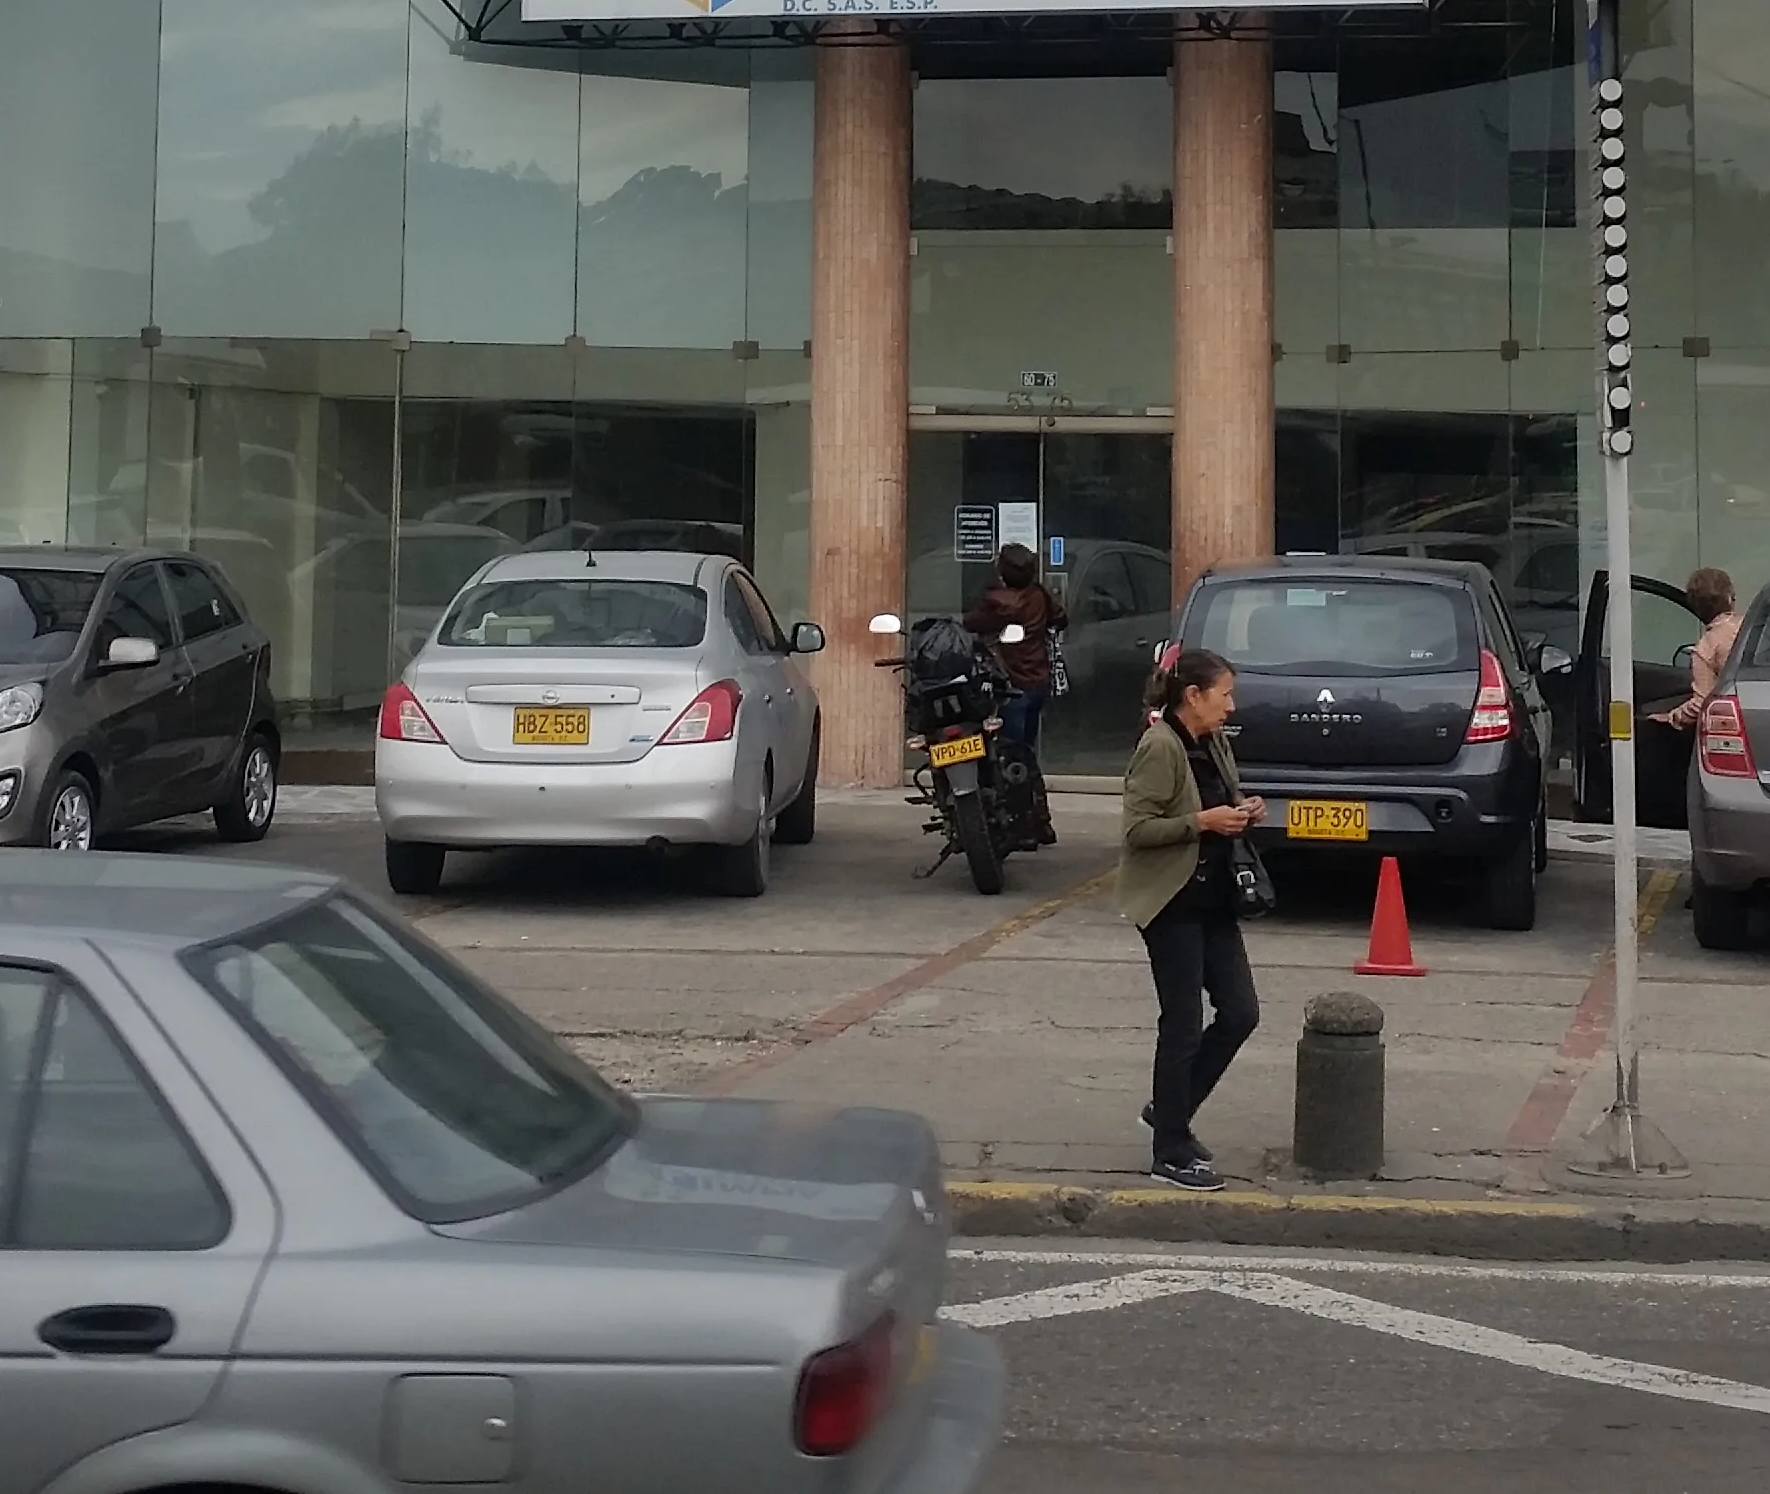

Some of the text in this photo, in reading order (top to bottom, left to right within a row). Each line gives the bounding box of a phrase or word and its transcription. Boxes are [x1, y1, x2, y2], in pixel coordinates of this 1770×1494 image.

[516, 714, 586, 734] HBZ 558
[1290, 713, 1362, 722] SANDERO
